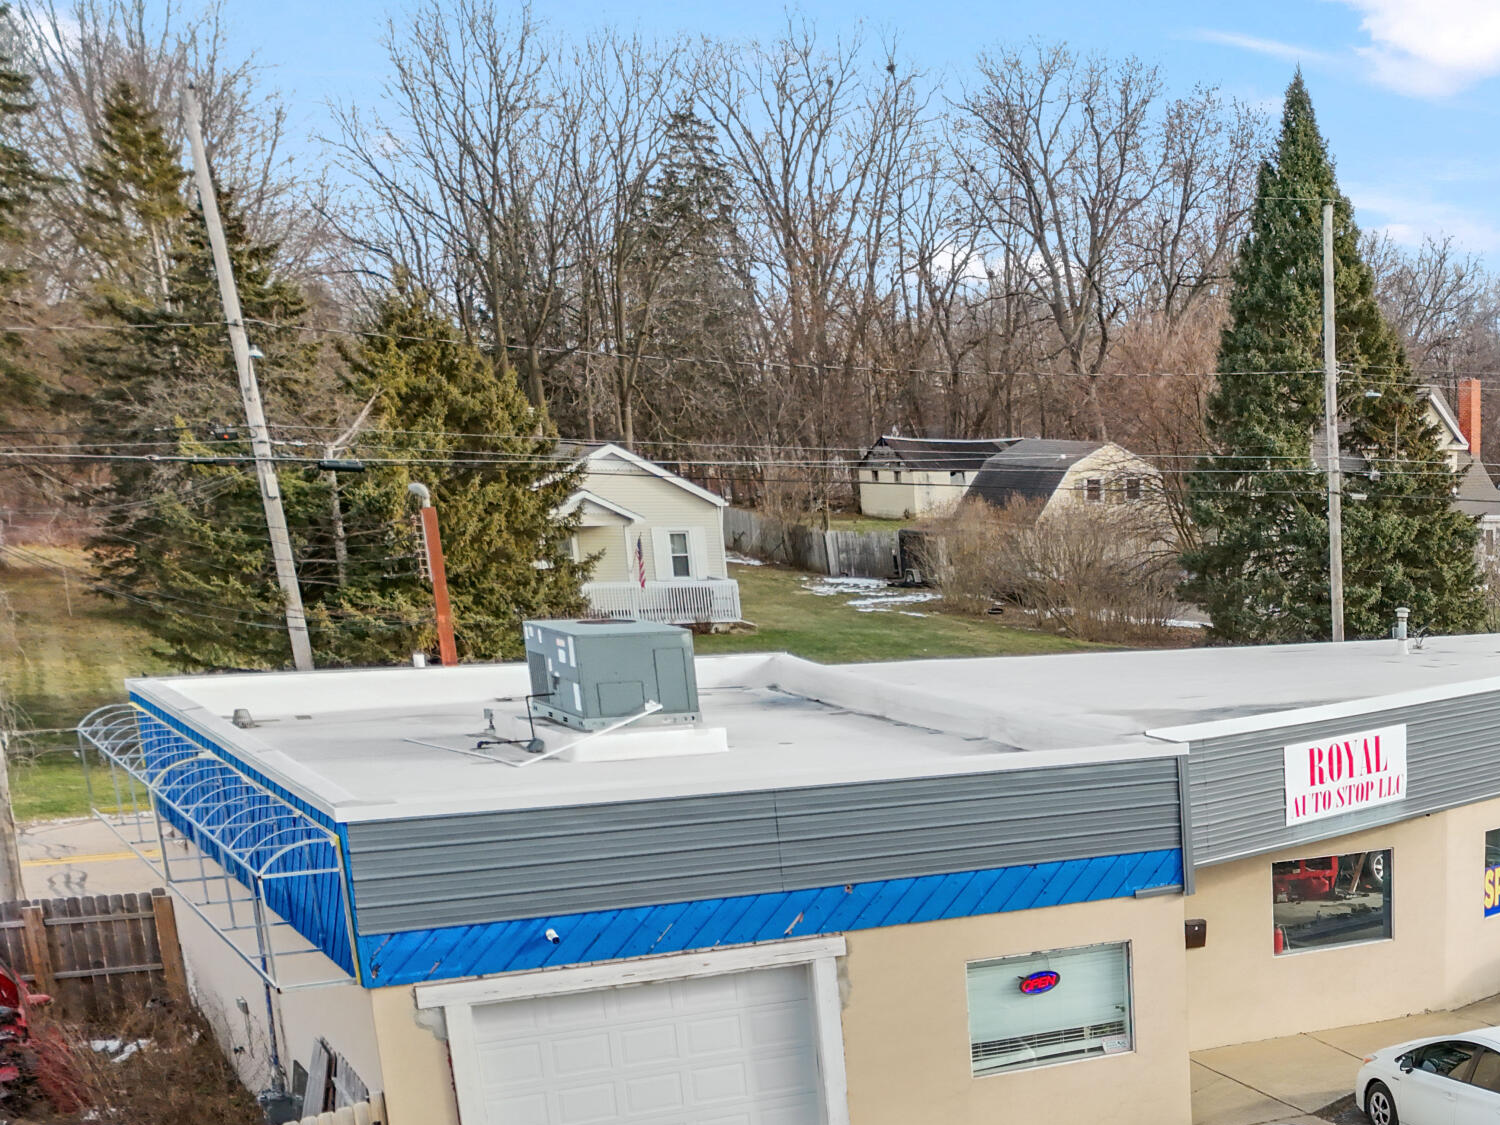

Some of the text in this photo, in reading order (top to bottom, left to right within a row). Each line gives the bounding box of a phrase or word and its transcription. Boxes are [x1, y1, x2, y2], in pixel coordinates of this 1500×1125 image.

[1308, 735, 1388, 787] ROYAL
[1291, 773, 1405, 819] AUTO STOP LLC
[1021, 974, 1057, 993] OPEN
